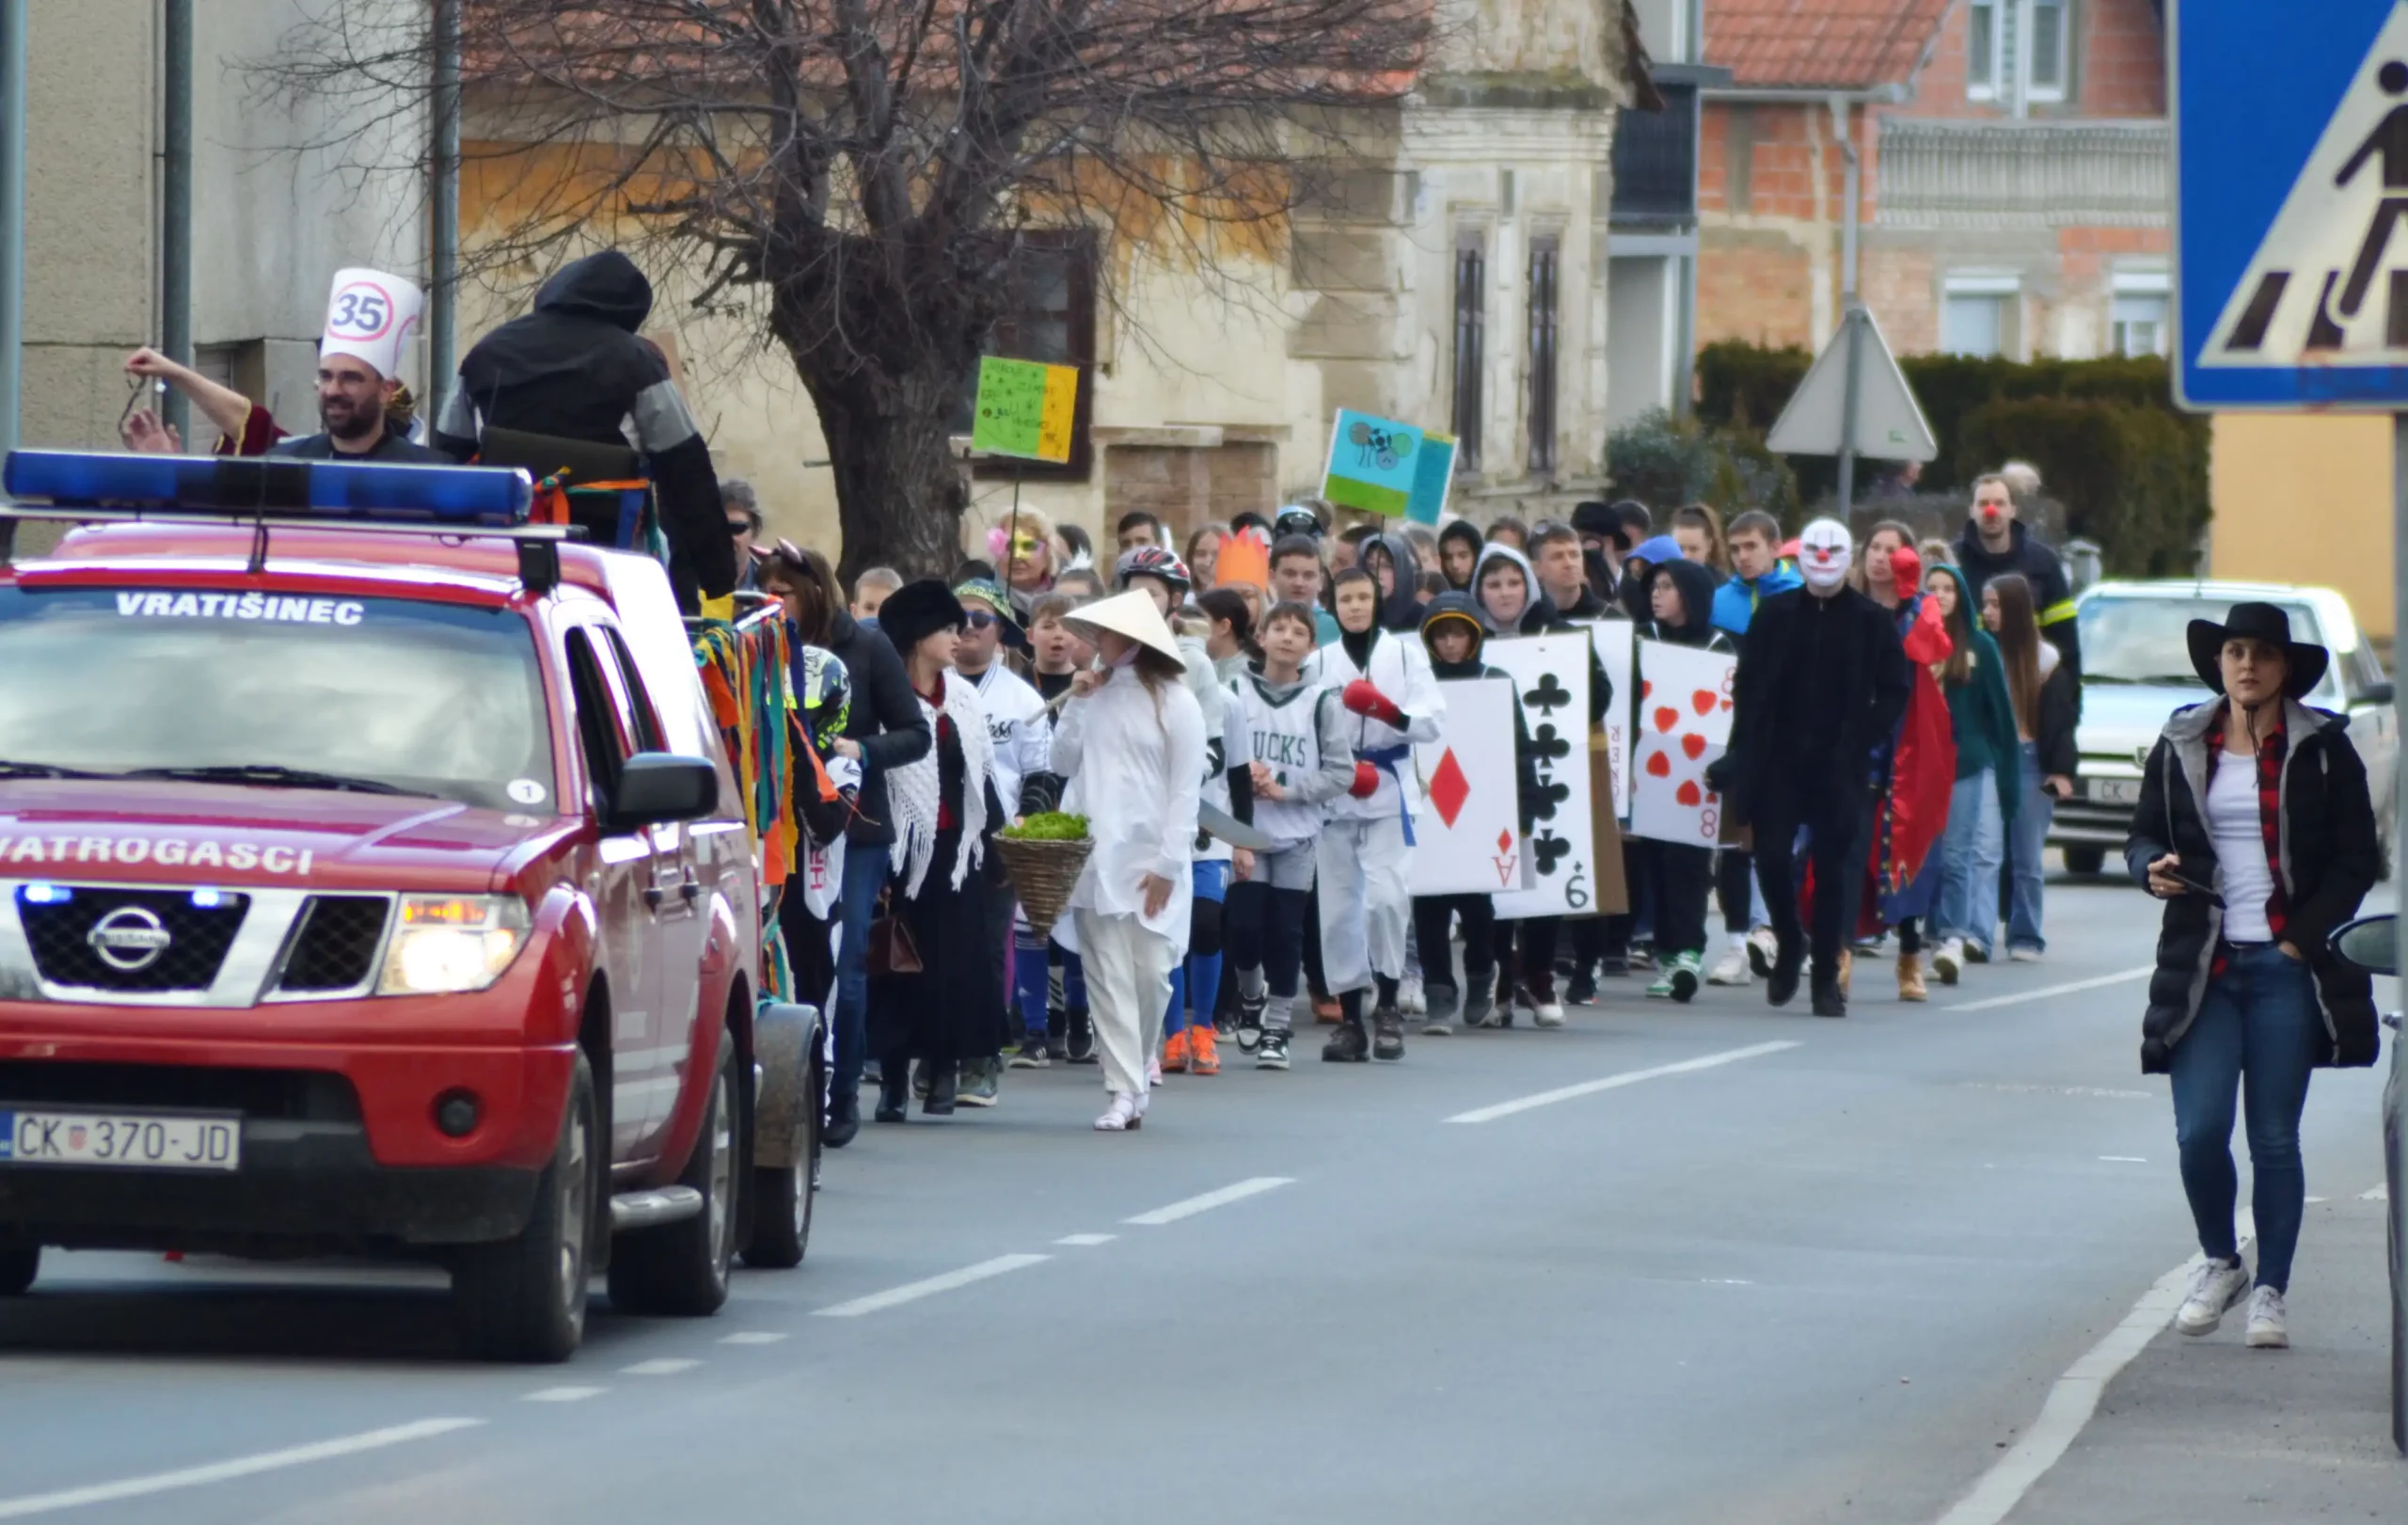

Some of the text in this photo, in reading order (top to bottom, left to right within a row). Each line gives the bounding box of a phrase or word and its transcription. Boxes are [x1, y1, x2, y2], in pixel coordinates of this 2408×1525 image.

[332, 294, 384, 331] 35
[117, 591, 364, 625] VRATIŠINEC
[1701, 809, 1717, 838] 8
[1492, 854, 1517, 887] A
[95, 1120, 230, 1161] 370-JD
